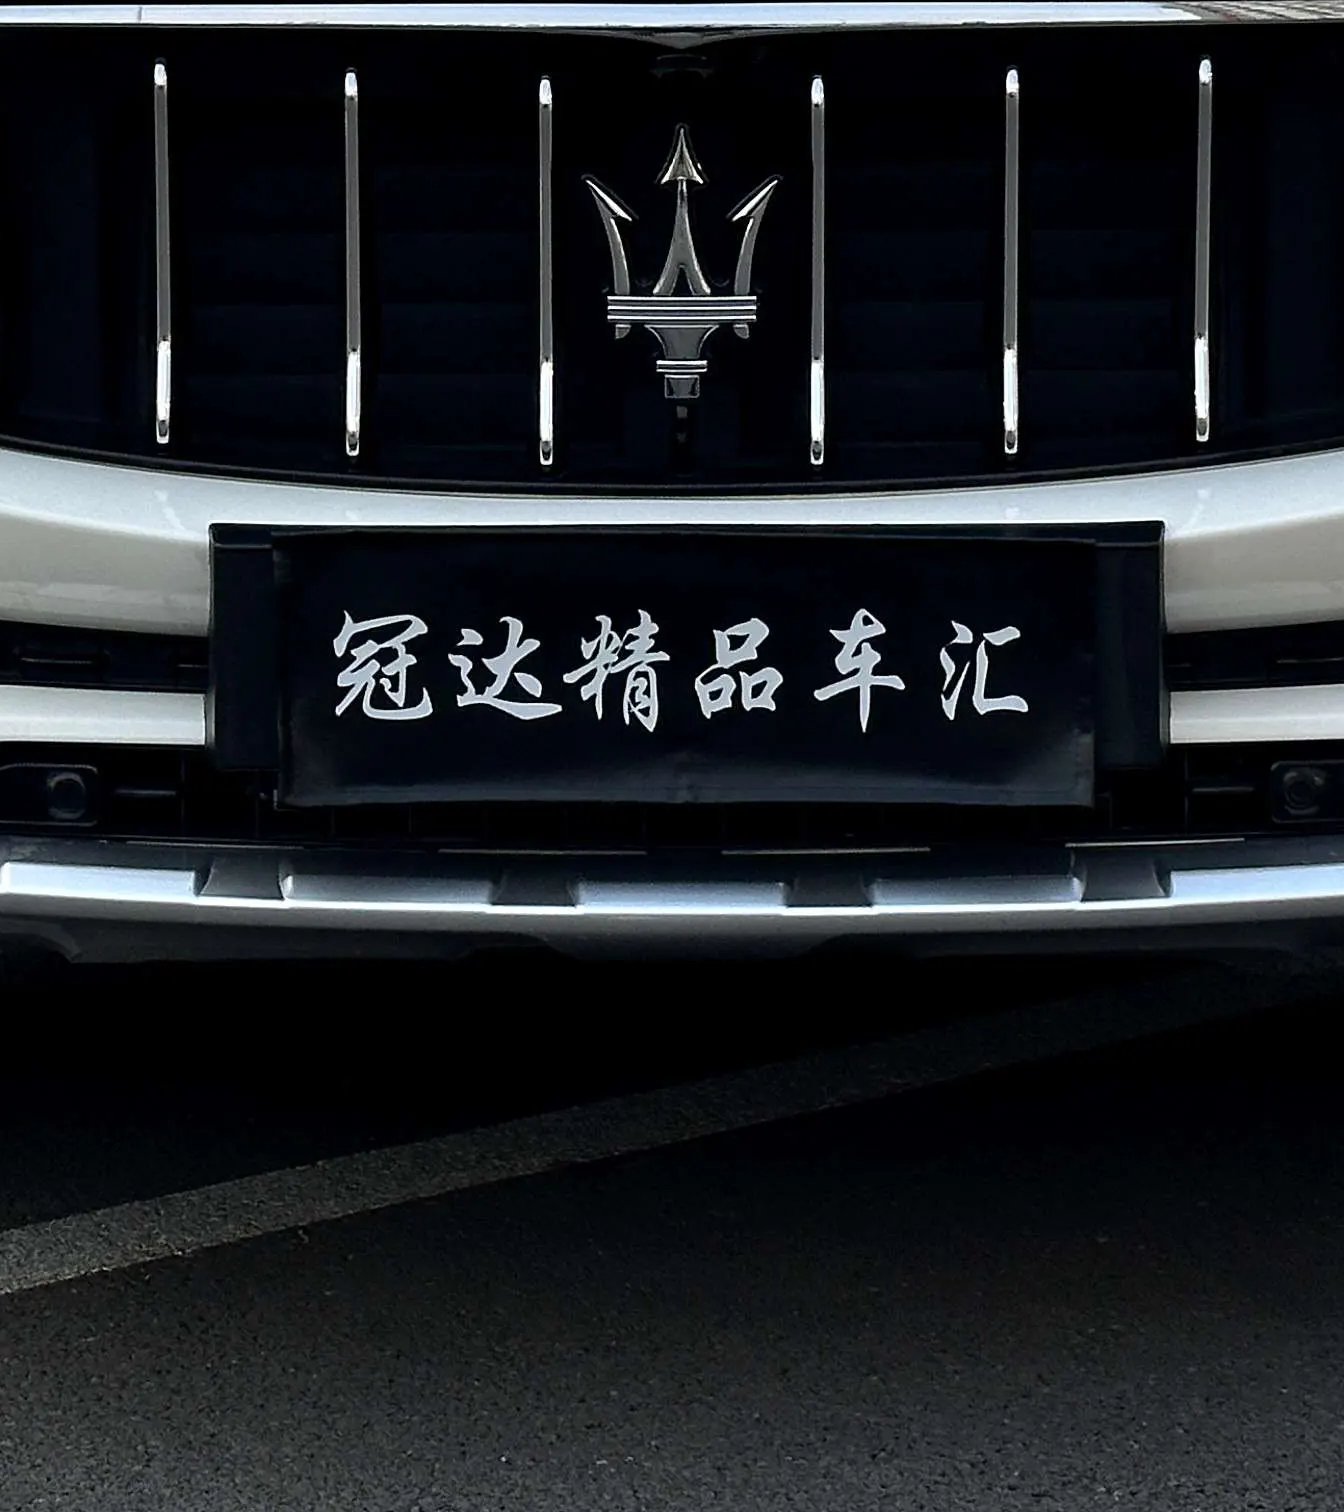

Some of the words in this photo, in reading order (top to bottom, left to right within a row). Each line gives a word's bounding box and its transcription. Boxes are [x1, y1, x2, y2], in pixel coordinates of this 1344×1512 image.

[333, 608, 1029, 733] 冠达精品车汇
